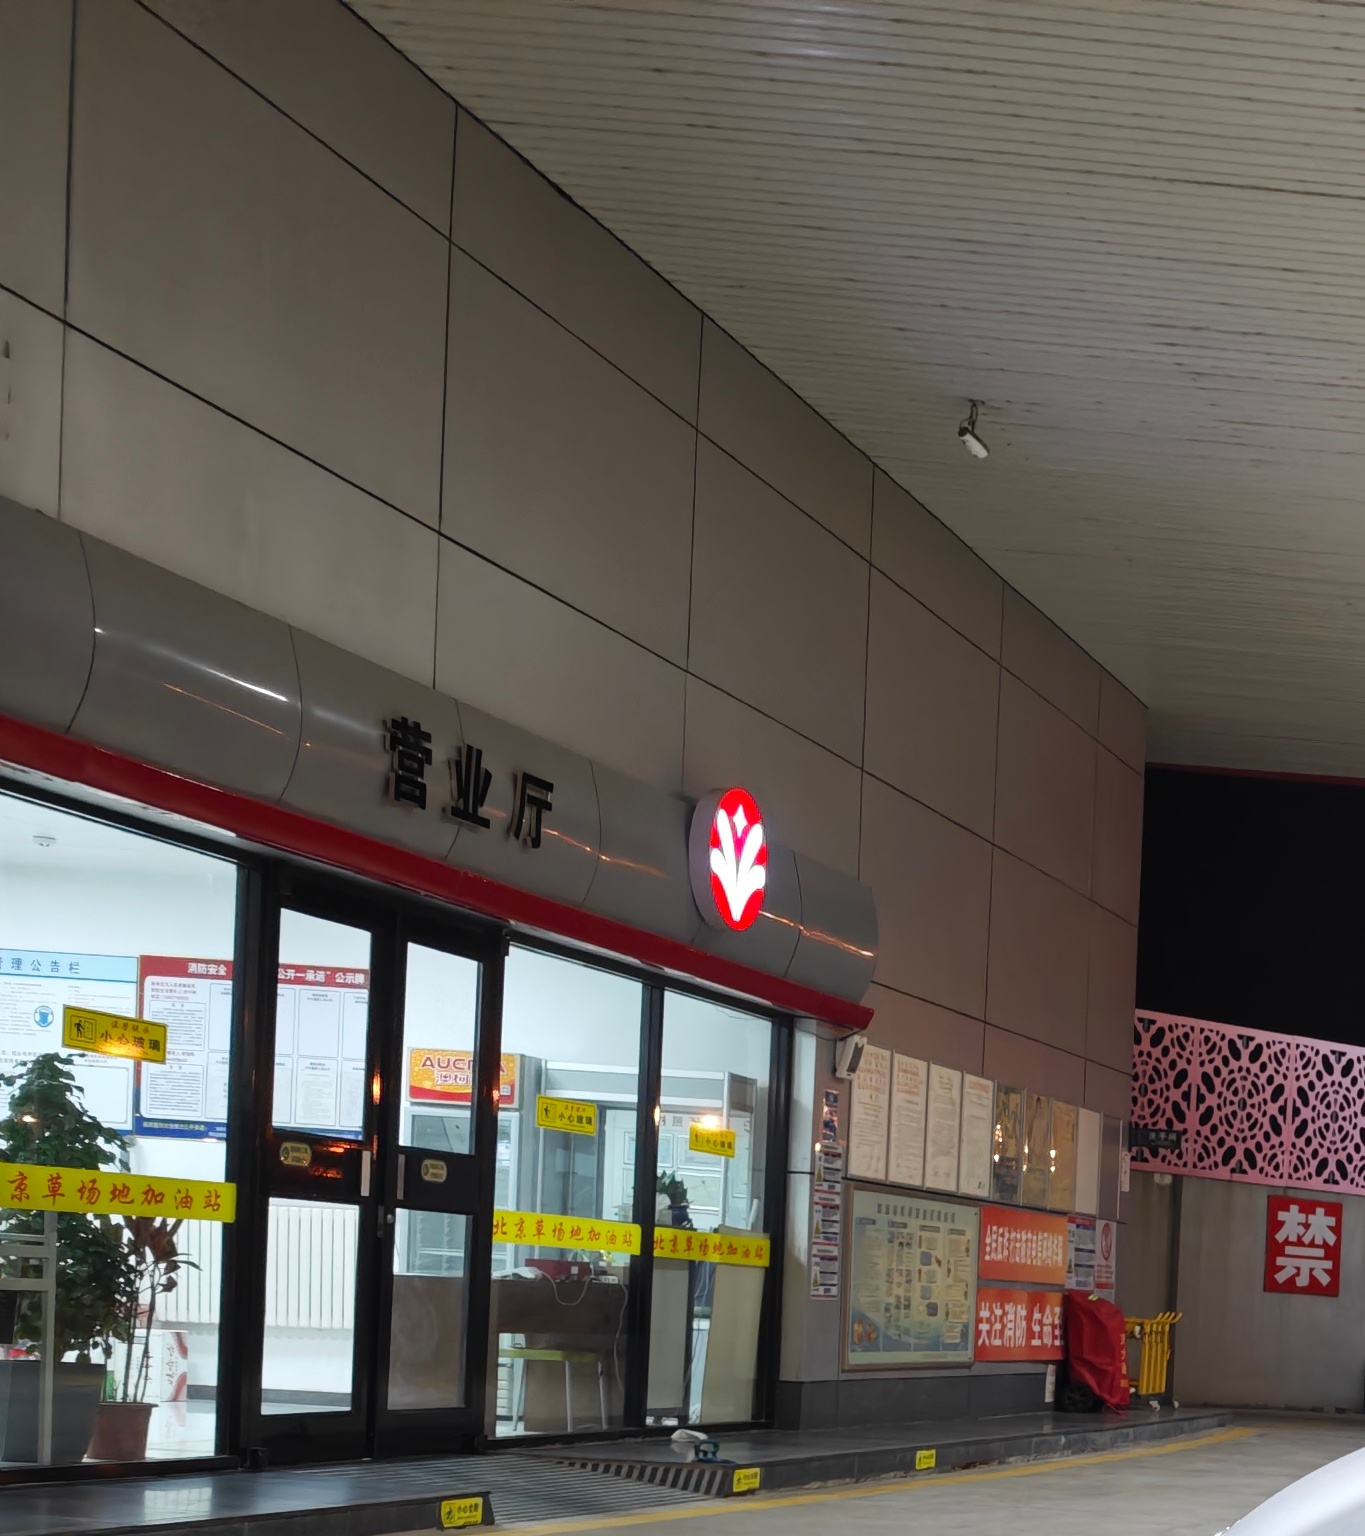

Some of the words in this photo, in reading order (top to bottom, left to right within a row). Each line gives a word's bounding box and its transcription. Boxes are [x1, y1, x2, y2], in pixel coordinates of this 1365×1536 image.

[384, 716, 554, 849] 营业厅
[0, 957, 81, 975] 理公告栏
[187, 963, 228, 976] 消防安全
[8, 1171, 222, 1212] 京草场地加油站
[493, 1215, 633, 1248] 北京草场地加油站
[653, 1232, 764, 1261] 北京草场地加油站
[977, 1301, 1027, 1348] 关注消防
